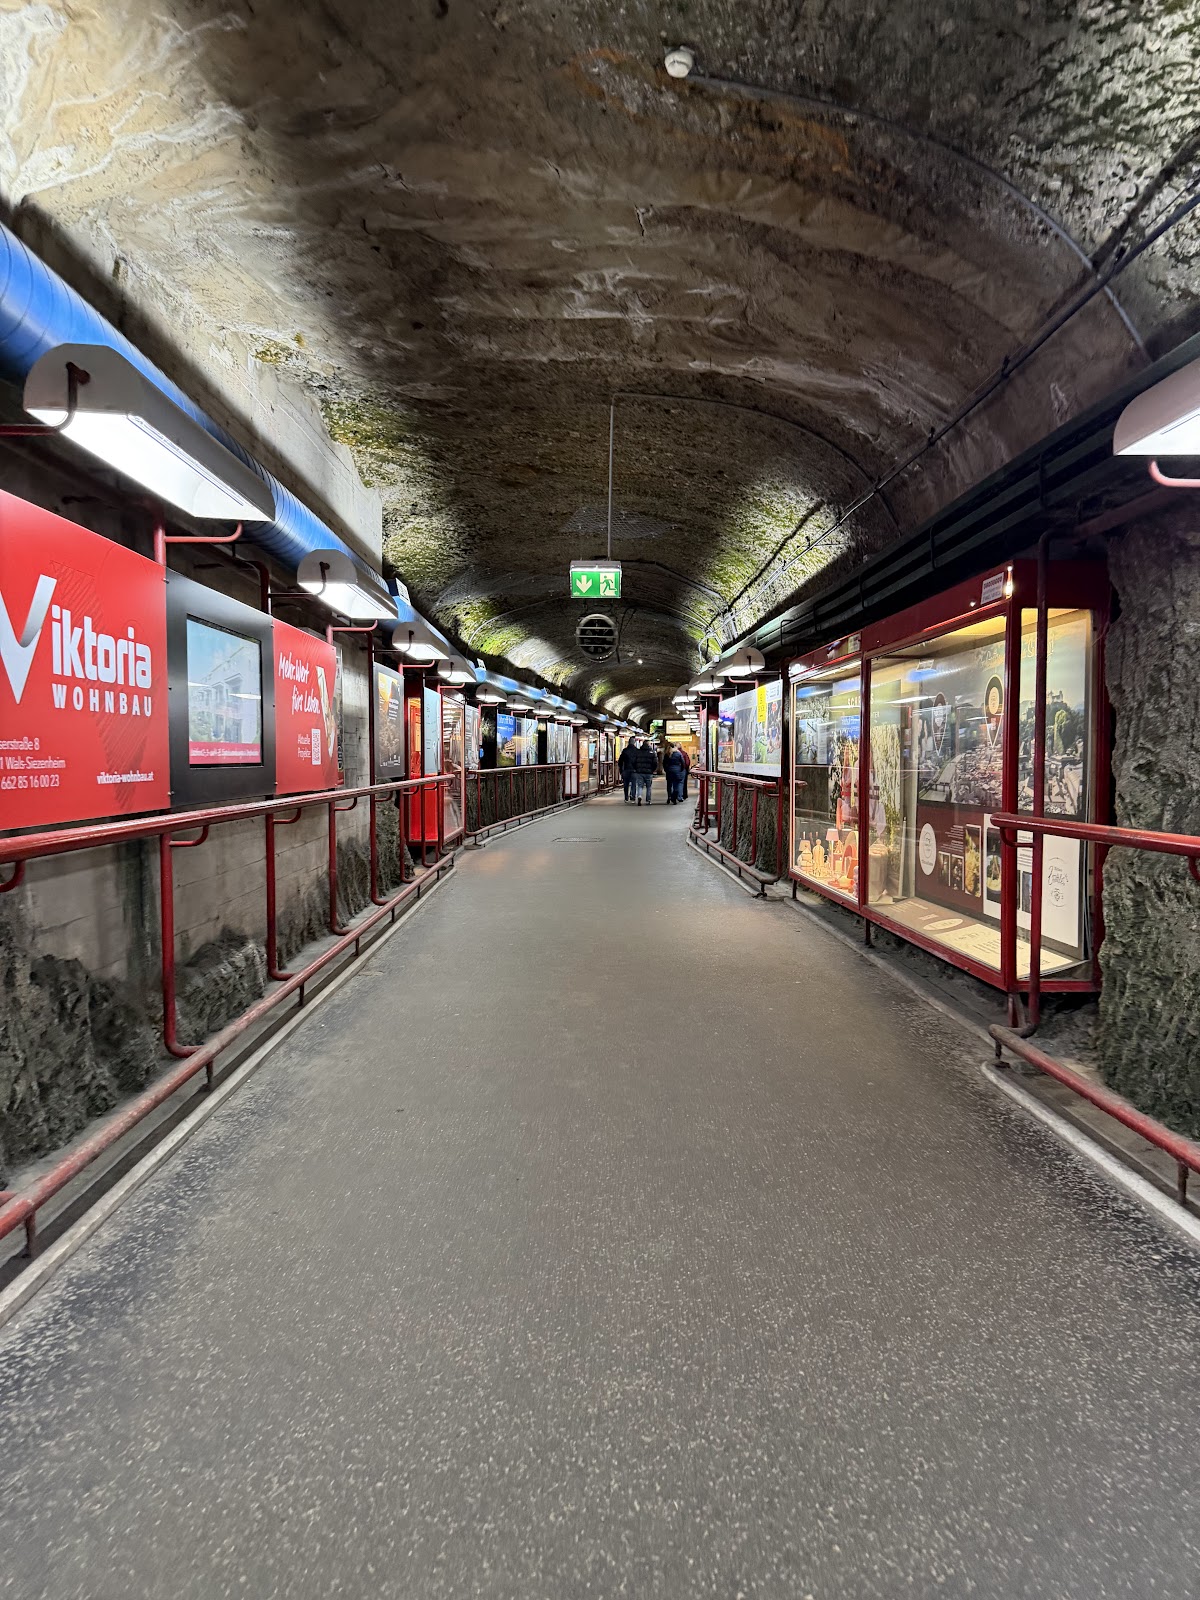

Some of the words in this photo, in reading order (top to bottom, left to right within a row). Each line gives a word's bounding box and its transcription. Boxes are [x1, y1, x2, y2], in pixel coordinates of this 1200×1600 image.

[52, 683, 152, 717] WOHNBAU
[34, 737, 40, 750] 8
[5, 755, 66, 769] Wals-Siezenheim
[18, 775, 28, 789] 85
[29, 775, 40, 788] 16
[40, 774, 50, 788] 00
[50, 774, 60, 787] 23
[96, 769, 154, 784] viktoria-wohnbau.at
